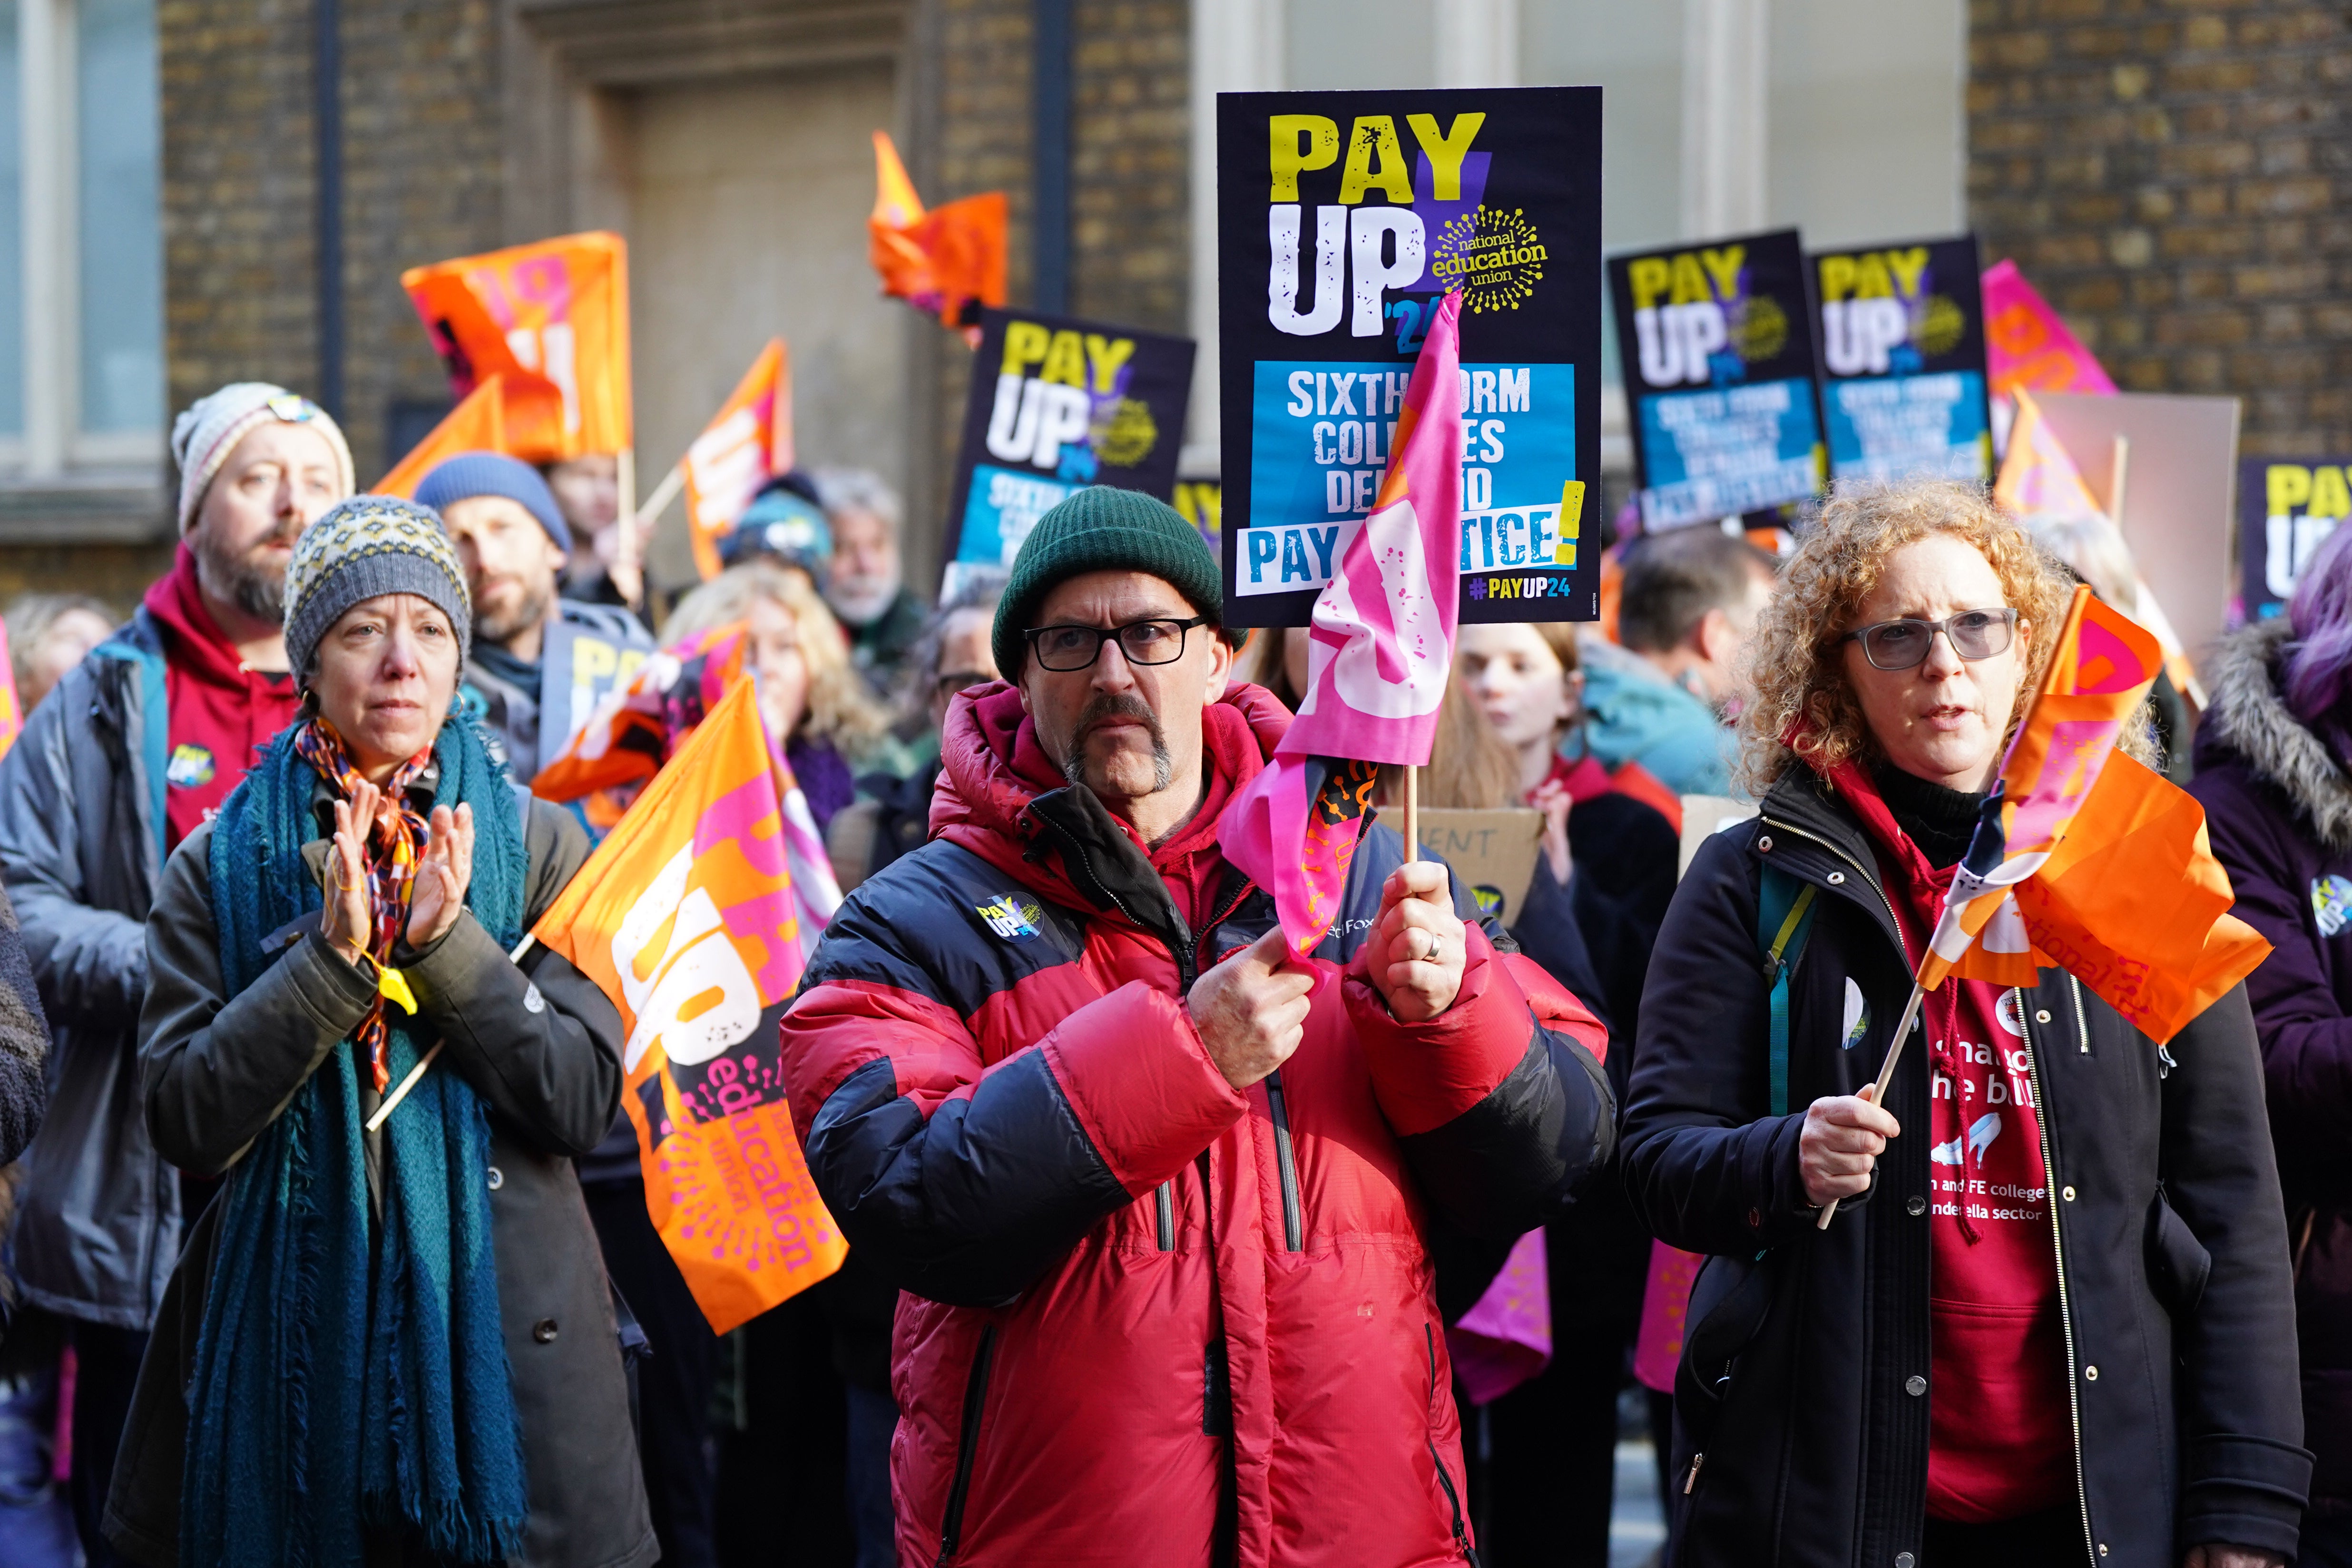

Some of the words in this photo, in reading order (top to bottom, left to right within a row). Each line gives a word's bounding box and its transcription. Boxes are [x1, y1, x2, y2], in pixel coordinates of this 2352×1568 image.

[1269, 112, 1486, 204] PAY
[1432, 244, 1548, 277] education
[1458, 229, 1516, 251] national
[1269, 205, 1426, 337] UP
[1385, 297, 1441, 354] '2
[1471, 270, 1513, 286] union
[1628, 244, 1747, 309] PAY
[1819, 247, 1930, 304] PAY
[1000, 321, 1136, 393] PAY
[1635, 301, 1729, 387] UP
[1822, 296, 1908, 376] UP
[986, 374, 1091, 469] UP
[1288, 371, 1409, 417] SIXTH
[2265, 464, 2352, 520] PA
[1248, 526, 1339, 583] PAY
[1469, 577, 1570, 600] #PAYUP24
[1418, 826, 1499, 858] ENT
[976, 896, 1016, 919] PAY
[986, 916, 1019, 937] UP
[611, 839, 762, 1075] UP
[1932, 1069, 1975, 1101] he
[707, 1057, 813, 1274] education
[708, 1137, 751, 1215] union
[1942, 1180, 1965, 1193] and
[1969, 1180, 1986, 1195] FE
[1992, 1208, 2042, 1221] sector
